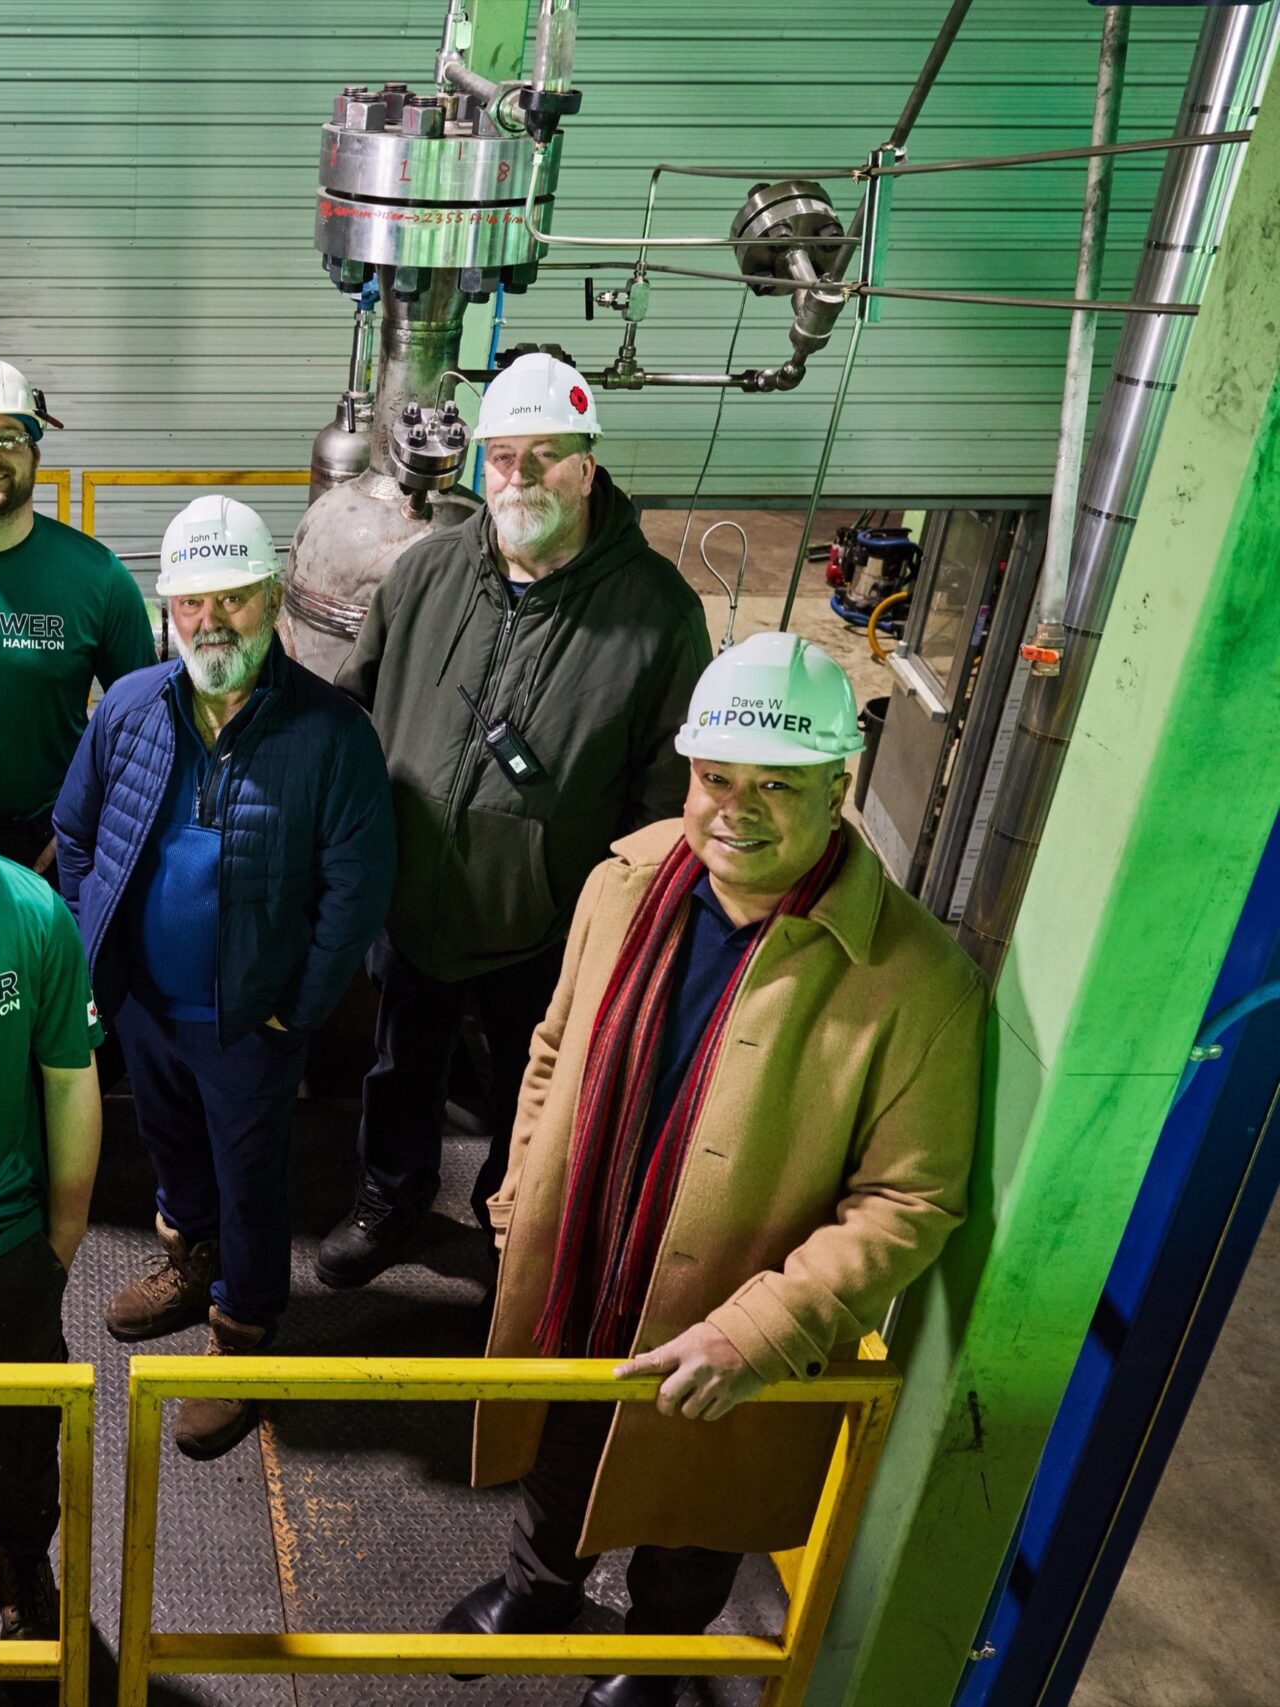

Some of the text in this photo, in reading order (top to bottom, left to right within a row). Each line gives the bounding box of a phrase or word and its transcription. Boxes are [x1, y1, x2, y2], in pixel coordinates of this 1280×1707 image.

[497, 161, 510, 182] 8
[510, 405, 542, 415] John H
[189, 532, 219, 543] John T
[3, 638, 65, 650] HAMILTON
[731, 696, 783, 710] Dave W
